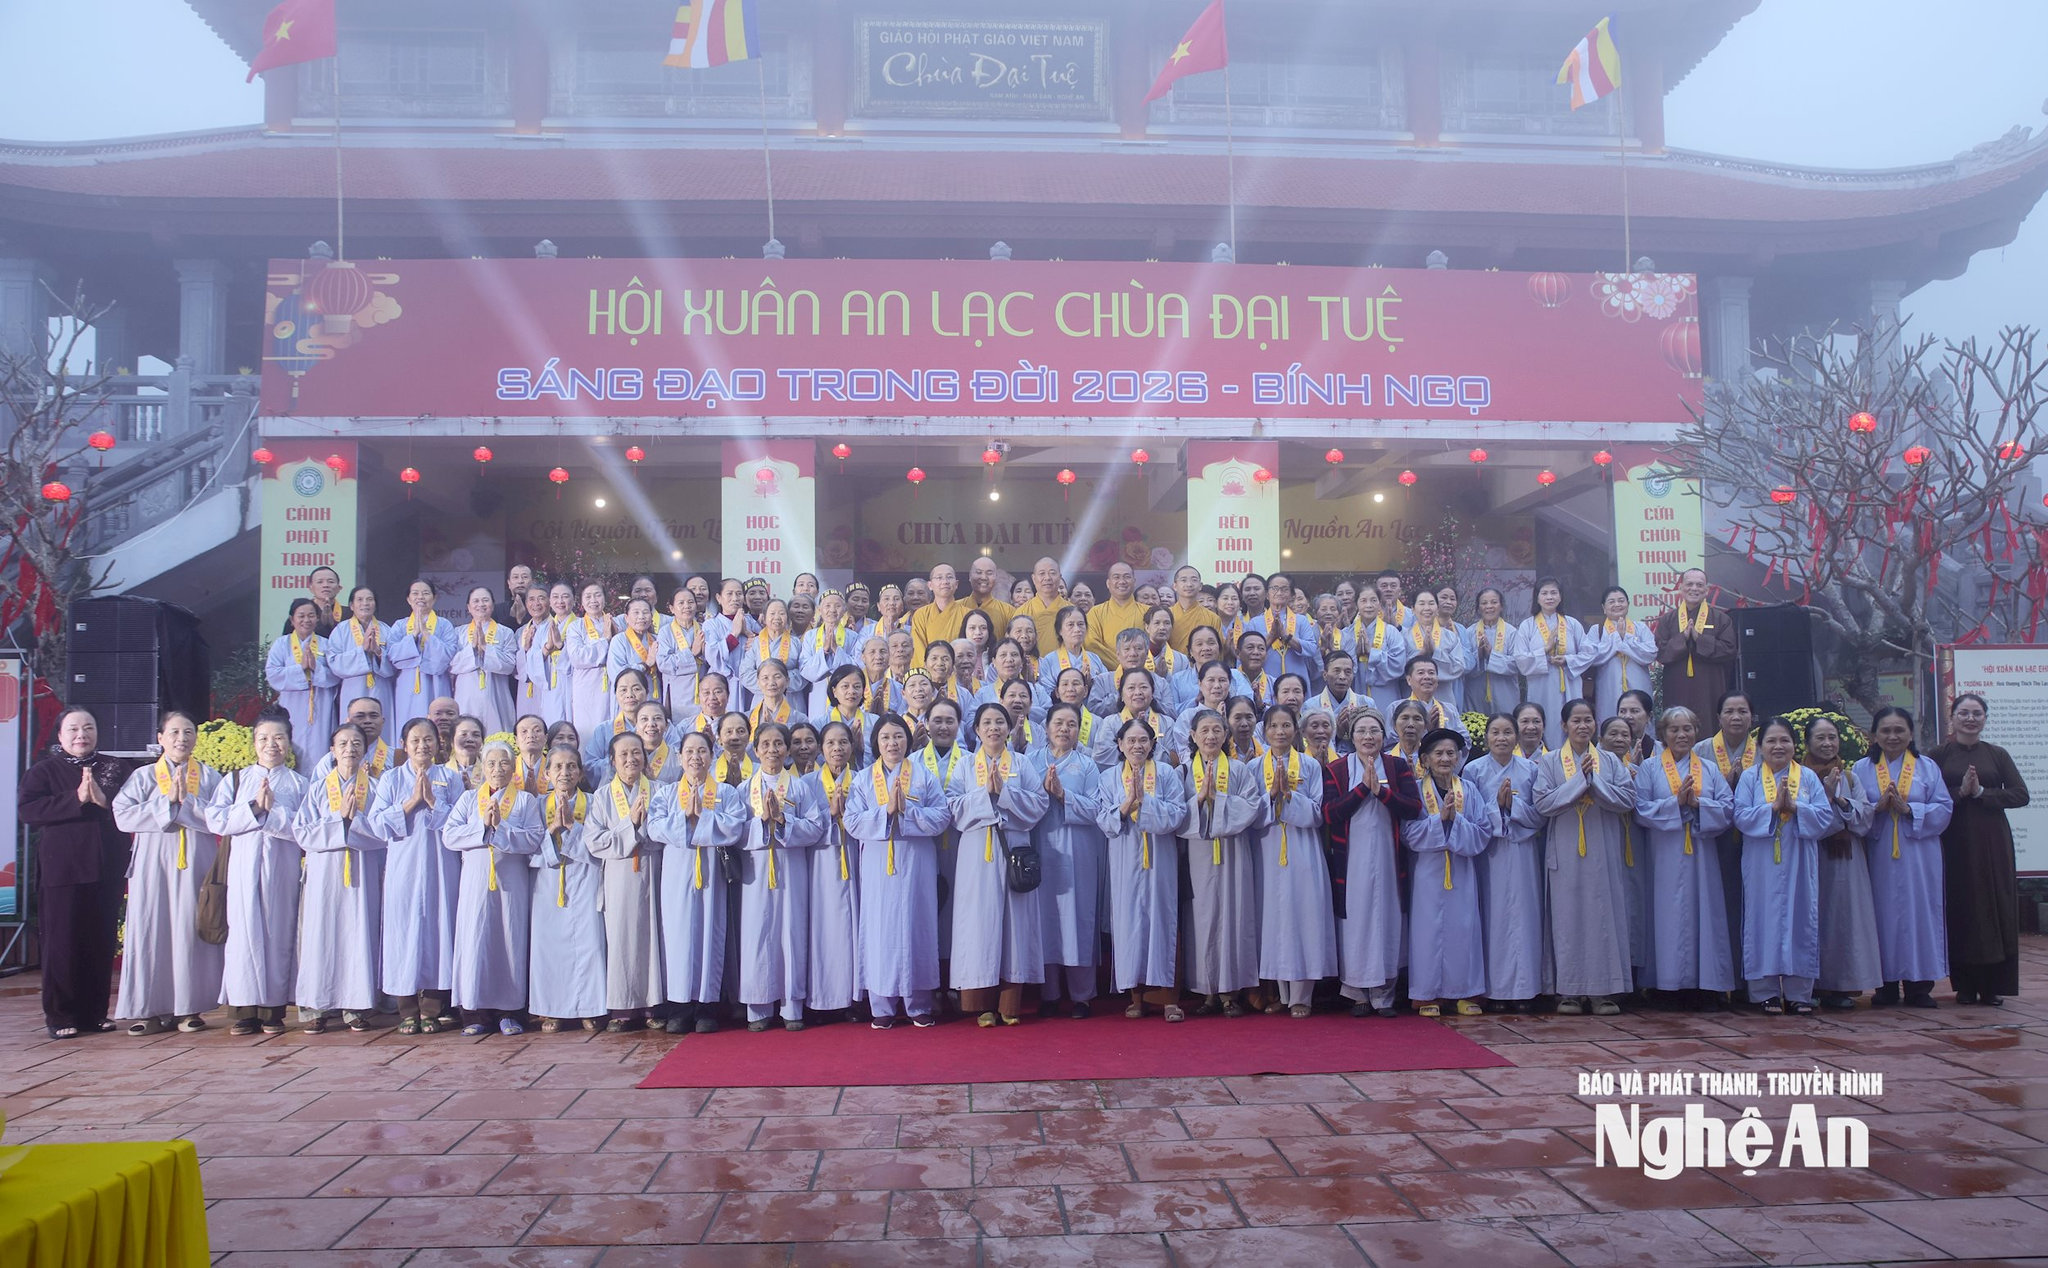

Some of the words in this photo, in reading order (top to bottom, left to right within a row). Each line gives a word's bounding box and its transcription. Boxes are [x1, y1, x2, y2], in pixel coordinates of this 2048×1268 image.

[880, 30, 913, 44] GIÁO
[918, 30, 940, 46] HỘI
[945, 31, 979, 48] PHẬT
[984, 32, 1016, 46] GIÁO
[1020, 33, 1049, 48] VIỆT
[1053, 35, 1084, 47] NAM
[882, 52, 963, 87] Chùa
[969, 52, 1030, 89] Đại
[1030, 54, 1081, 90] Tuệ
[588, 275, 662, 346] HỘI
[683, 275, 820, 336] XUÂN
[841, 289, 910, 336] AN
[930, 289, 1035, 348] LẠC
[1055, 278, 1190, 339] CHÙA
[1209, 292, 1289, 351] ĐẠI
[1307, 284, 1404, 353] TUỆ
[495, 357, 644, 402] SÁNG
[653, 367, 767, 409] ĐẠO
[777, 368, 960, 403] TRONG
[969, 360, 1059, 403] ĐỜI
[1072, 369, 1209, 404] 2026
[1252, 362, 1371, 407] BÍNH
[1385, 373, 1491, 415] NGỌ
[746, 515, 779, 531] HỌC
[1218, 514, 1250, 529] RÈN
[1284, 515, 1352, 544] Nguồn
[1355, 519, 1388, 539] An
[286, 527, 330, 546] PHẬT
[703, 518, 722, 544] Li
[897, 516, 966, 545] CHÙA
[974, 522, 1020, 553] ĐẠI
[746, 537, 781, 553] ĐẠO
[1216, 536, 1253, 551] TÂM
[281, 552, 335, 566] TRANG
[746, 556, 781, 574] TIẾN
[1215, 558, 1253, 573] NUÔI
[1636, 550, 1687, 564] THANH
[272, 575, 311, 589] NGHI
[2015, 665, 2023, 673] AN
